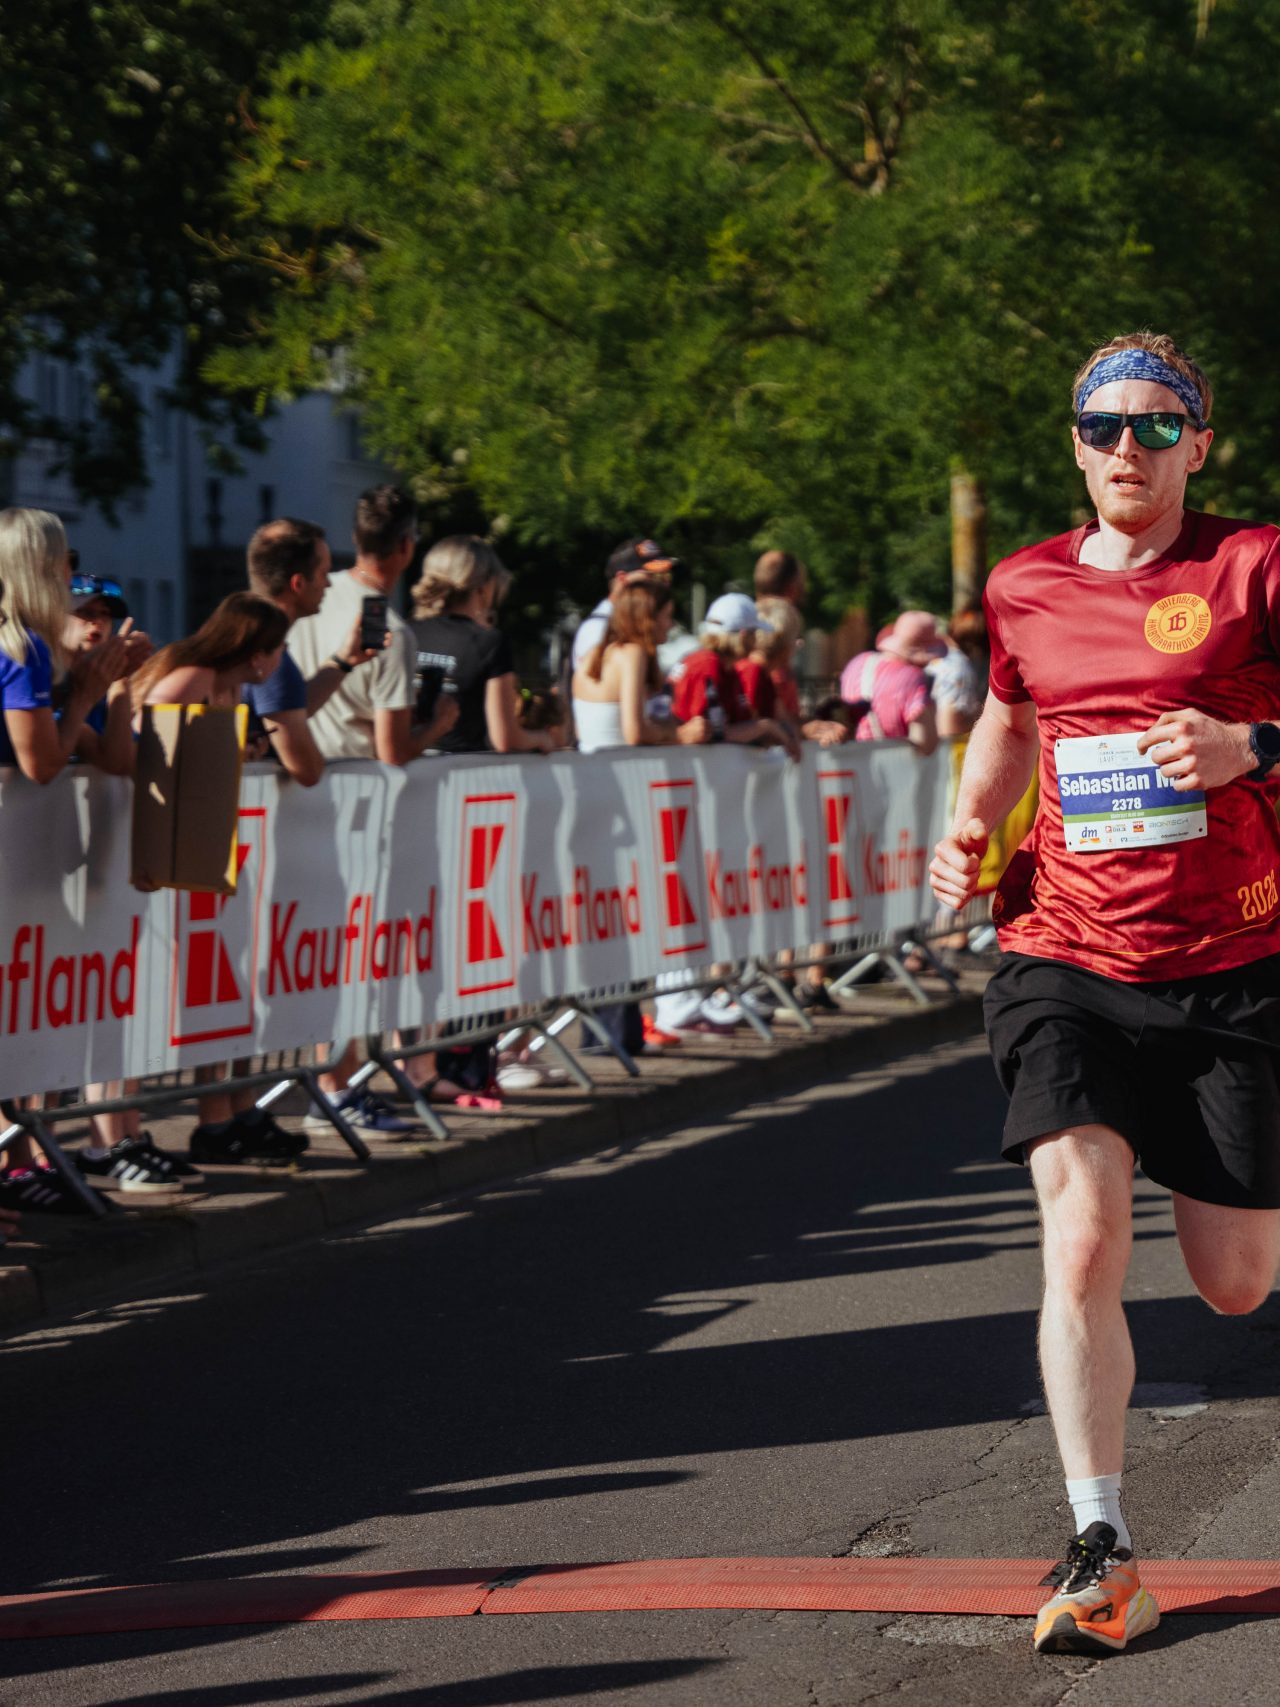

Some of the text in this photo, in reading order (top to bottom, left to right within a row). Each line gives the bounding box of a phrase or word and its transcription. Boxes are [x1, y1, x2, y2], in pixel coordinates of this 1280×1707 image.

[1156, 595, 1201, 611] GUTENBERG
[1147, 612, 1209, 651] HALBMARATHON MAINZ
[1060, 772, 1150, 797] Sebastian
[1111, 797, 1142, 811] 2378
[1081, 826, 1098, 838] dm
[521, 860, 641, 954] Kaufland
[267, 885, 437, 998] Kaufland
[0, 914, 141, 1037] fland
